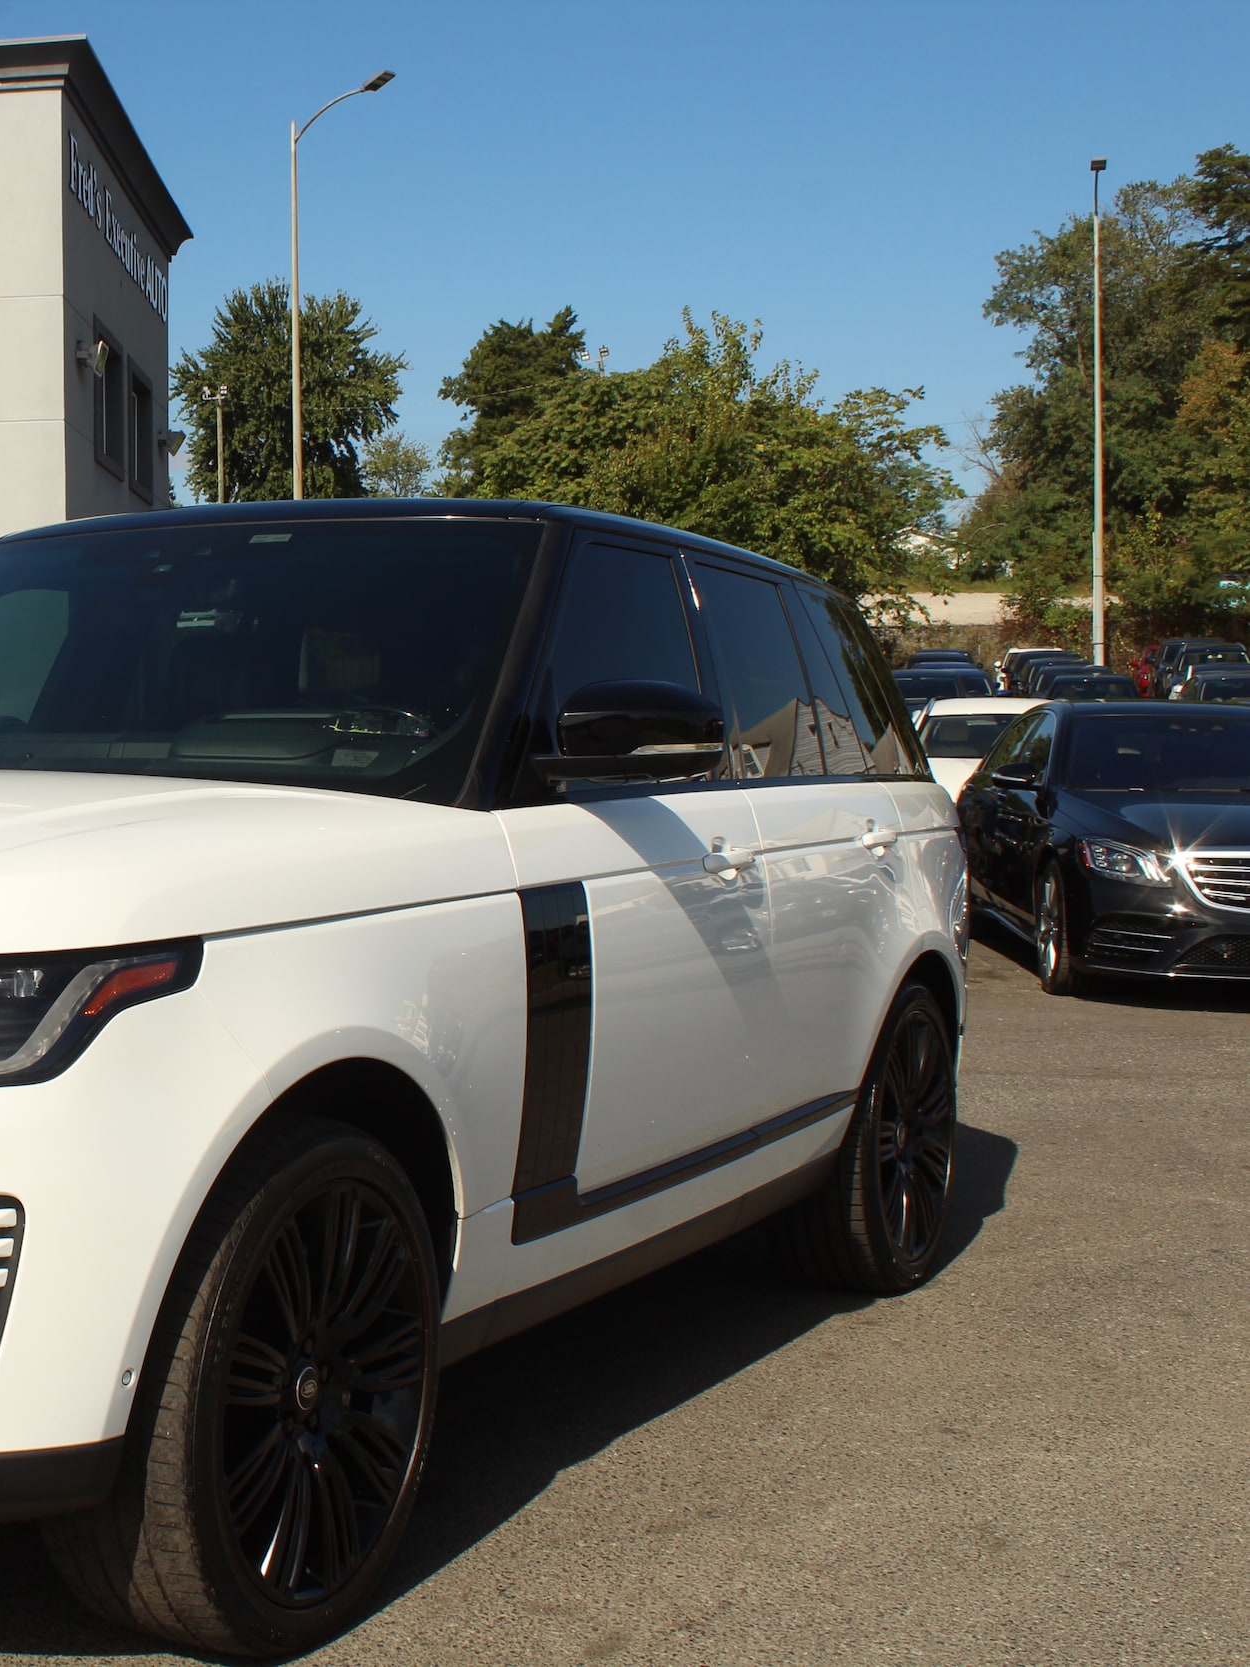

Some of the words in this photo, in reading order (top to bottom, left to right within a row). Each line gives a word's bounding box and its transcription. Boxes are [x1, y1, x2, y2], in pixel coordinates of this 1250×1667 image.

[69, 131, 102, 230] Fred's
[103, 185, 146, 291] Executive
[145, 253, 168, 323] AUTO
